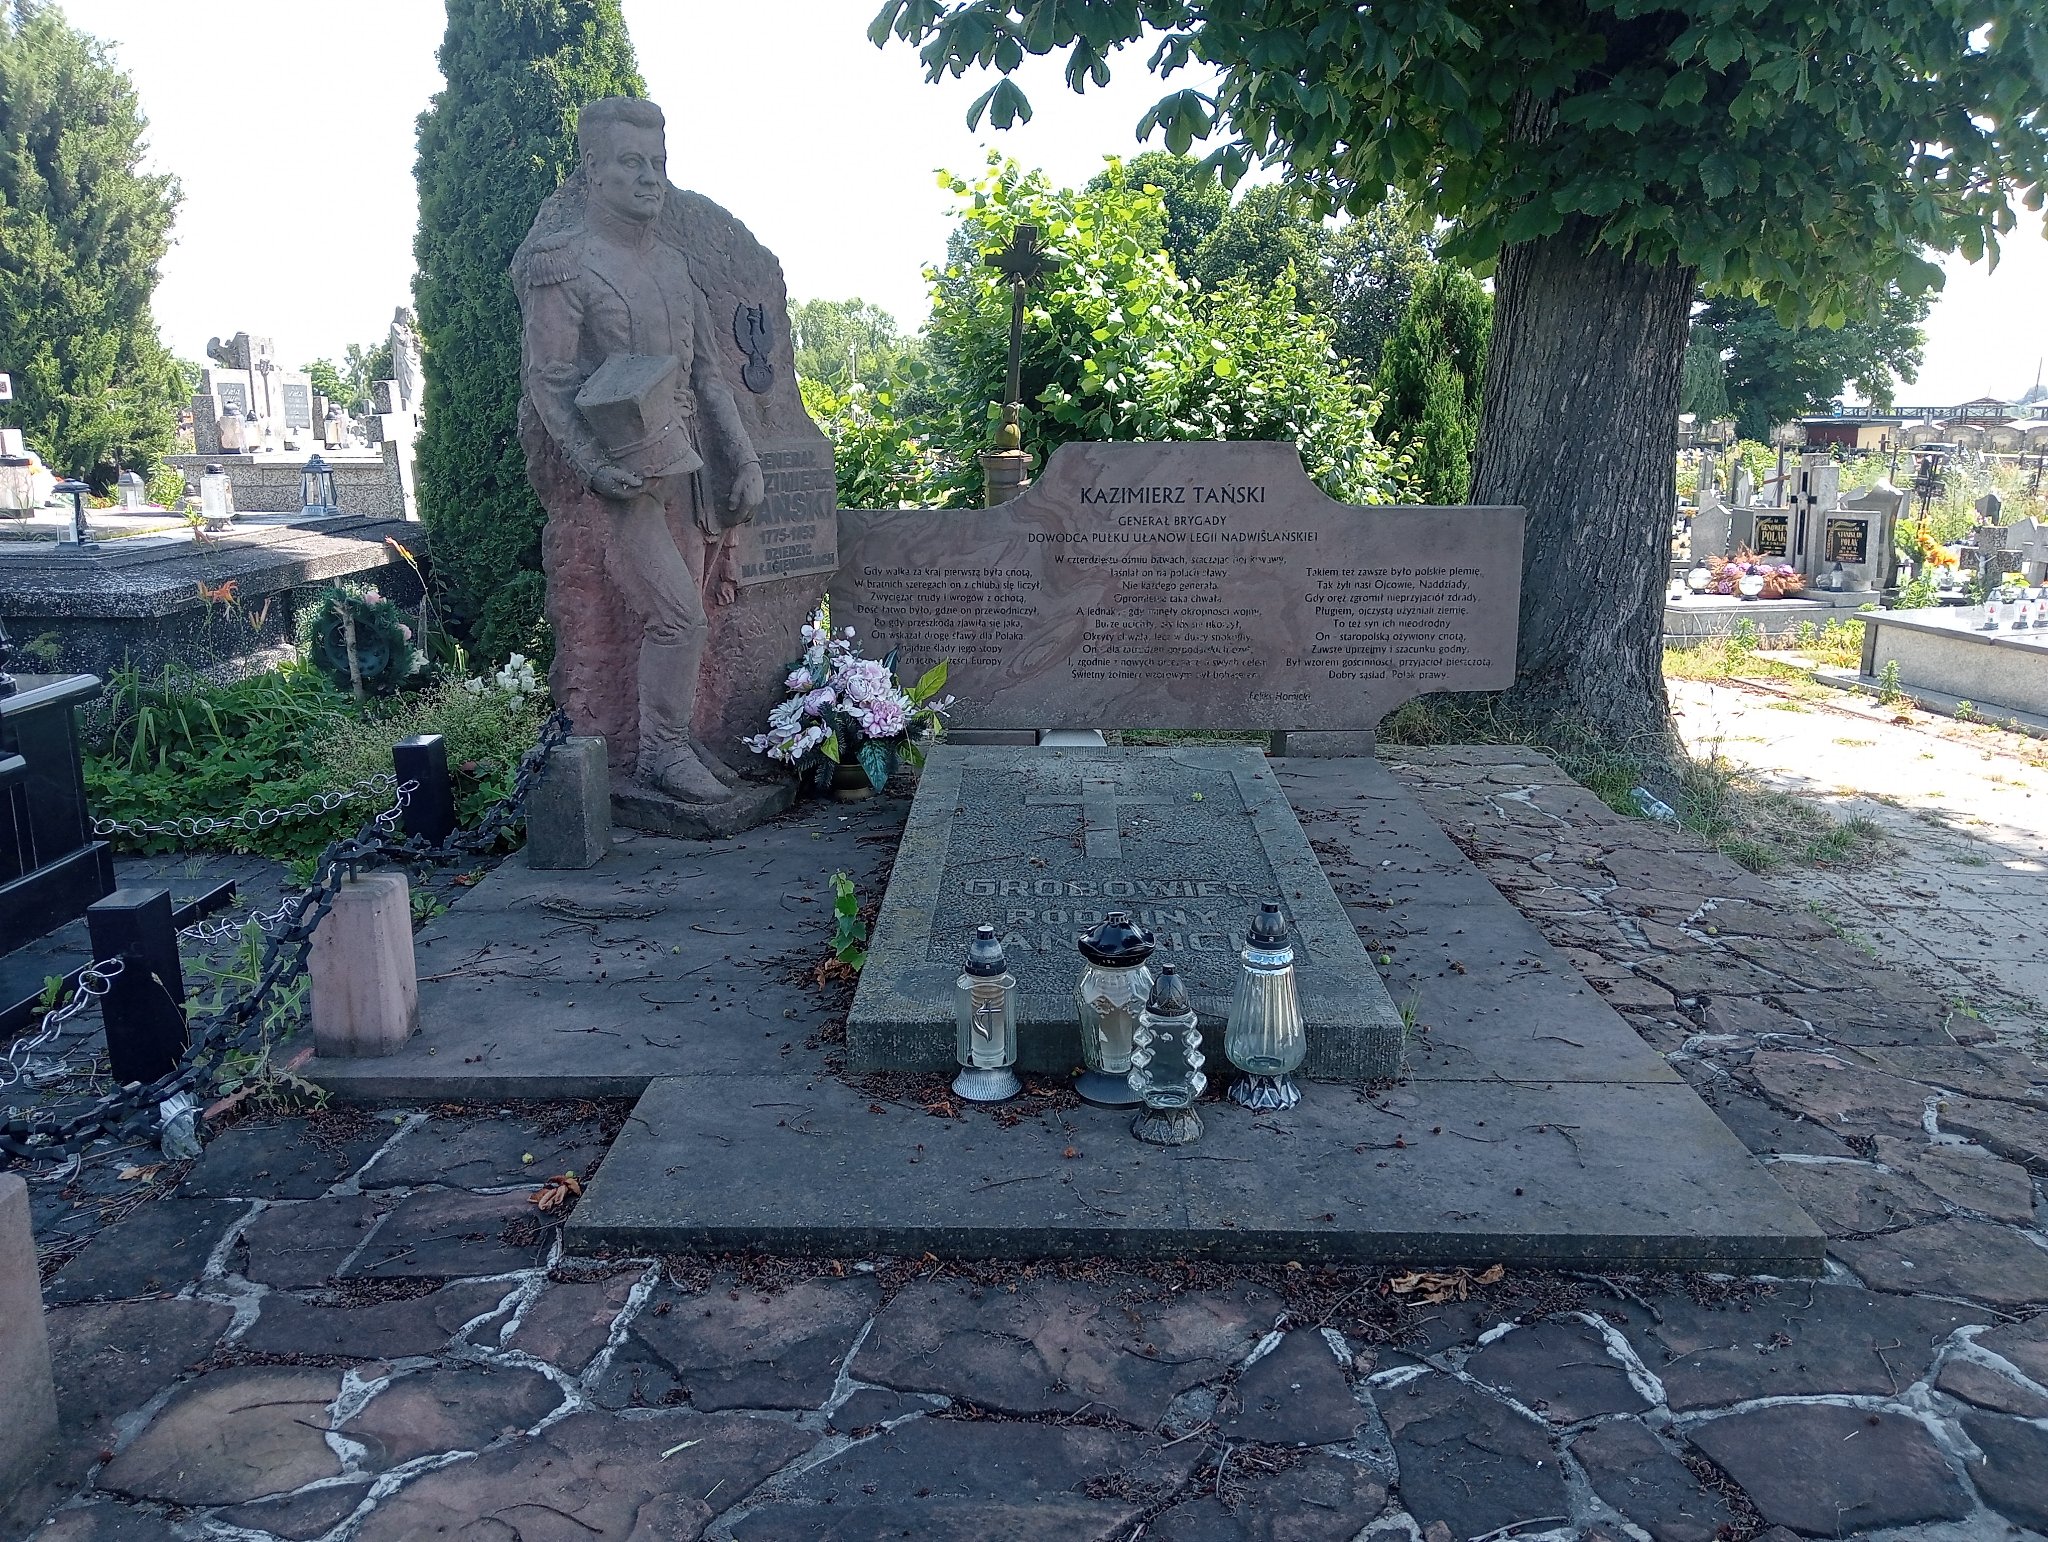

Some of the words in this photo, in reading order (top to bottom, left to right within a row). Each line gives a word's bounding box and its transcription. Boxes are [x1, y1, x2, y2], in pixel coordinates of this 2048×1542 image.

[764, 468, 832, 491] ZIMIERZ
[1080, 487, 1186, 504] KAZIMIERZ
[1193, 483, 1265, 504] TAŃSKI
[1118, 515, 1170, 526] GENERAŁ
[1174, 515, 1227, 526] BRYGADY
[1092, 532, 1129, 543] PUŁKU
[1190, 532, 1217, 542] LEGII
[1221, 530, 1318, 542] NADWIŚLAŃSKIEJ
[1054, 555, 1064, 564] W
[864, 566, 882, 576] Gdy
[886, 568, 909, 576] walka
[925, 568, 941, 576] kraj
[984, 568, 1002, 577] była
[1306, 568, 1338, 576] Takiem
[1391, 567, 1412, 577] było
[1415, 567, 1446, 577] polskie
[854, 580, 864, 588] W
[867, 580, 902, 588] bratnich
[906, 580, 946, 590] szeregach
[1003, 581, 1014, 590] się
[1122, 581, 1138, 590] Nie
[1317, 580, 1333, 589] Tak
[1374, 580, 1415, 590] Ojcowie,
[918, 594, 940, 602] trudy
[1305, 593, 1325, 603] Gdy
[910, 606, 932, 614] było,
[1076, 607, 1084, 616] A
[1316, 606, 1354, 616] Pługiem,
[888, 618, 904, 628] gdy
[989, 620, 1000, 628] się
[1004, 620, 1023, 628] jaka,
[1333, 619, 1345, 628] To
[1365, 621, 1378, 629] syn
[1382, 619, 1395, 628] ich
[1399, 619, 1450, 629] nieodrodny
[872, 630, 885, 638] On
[980, 632, 992, 640] dla
[1316, 632, 1330, 641] On
[1340, 632, 1389, 642] staropolską
[901, 644, 930, 652] najdzie
[934, 644, 956, 652] ślady
[1083, 645, 1096, 653] On
[1106, 645, 1120, 653] dla
[1396, 645, 1435, 653] szacunku
[972, 656, 1001, 666] Europy
[1078, 657, 1110, 667] zgodnie
[1329, 670, 1356, 679] Dobry
[1006, 908, 1218, 926] RODINY
